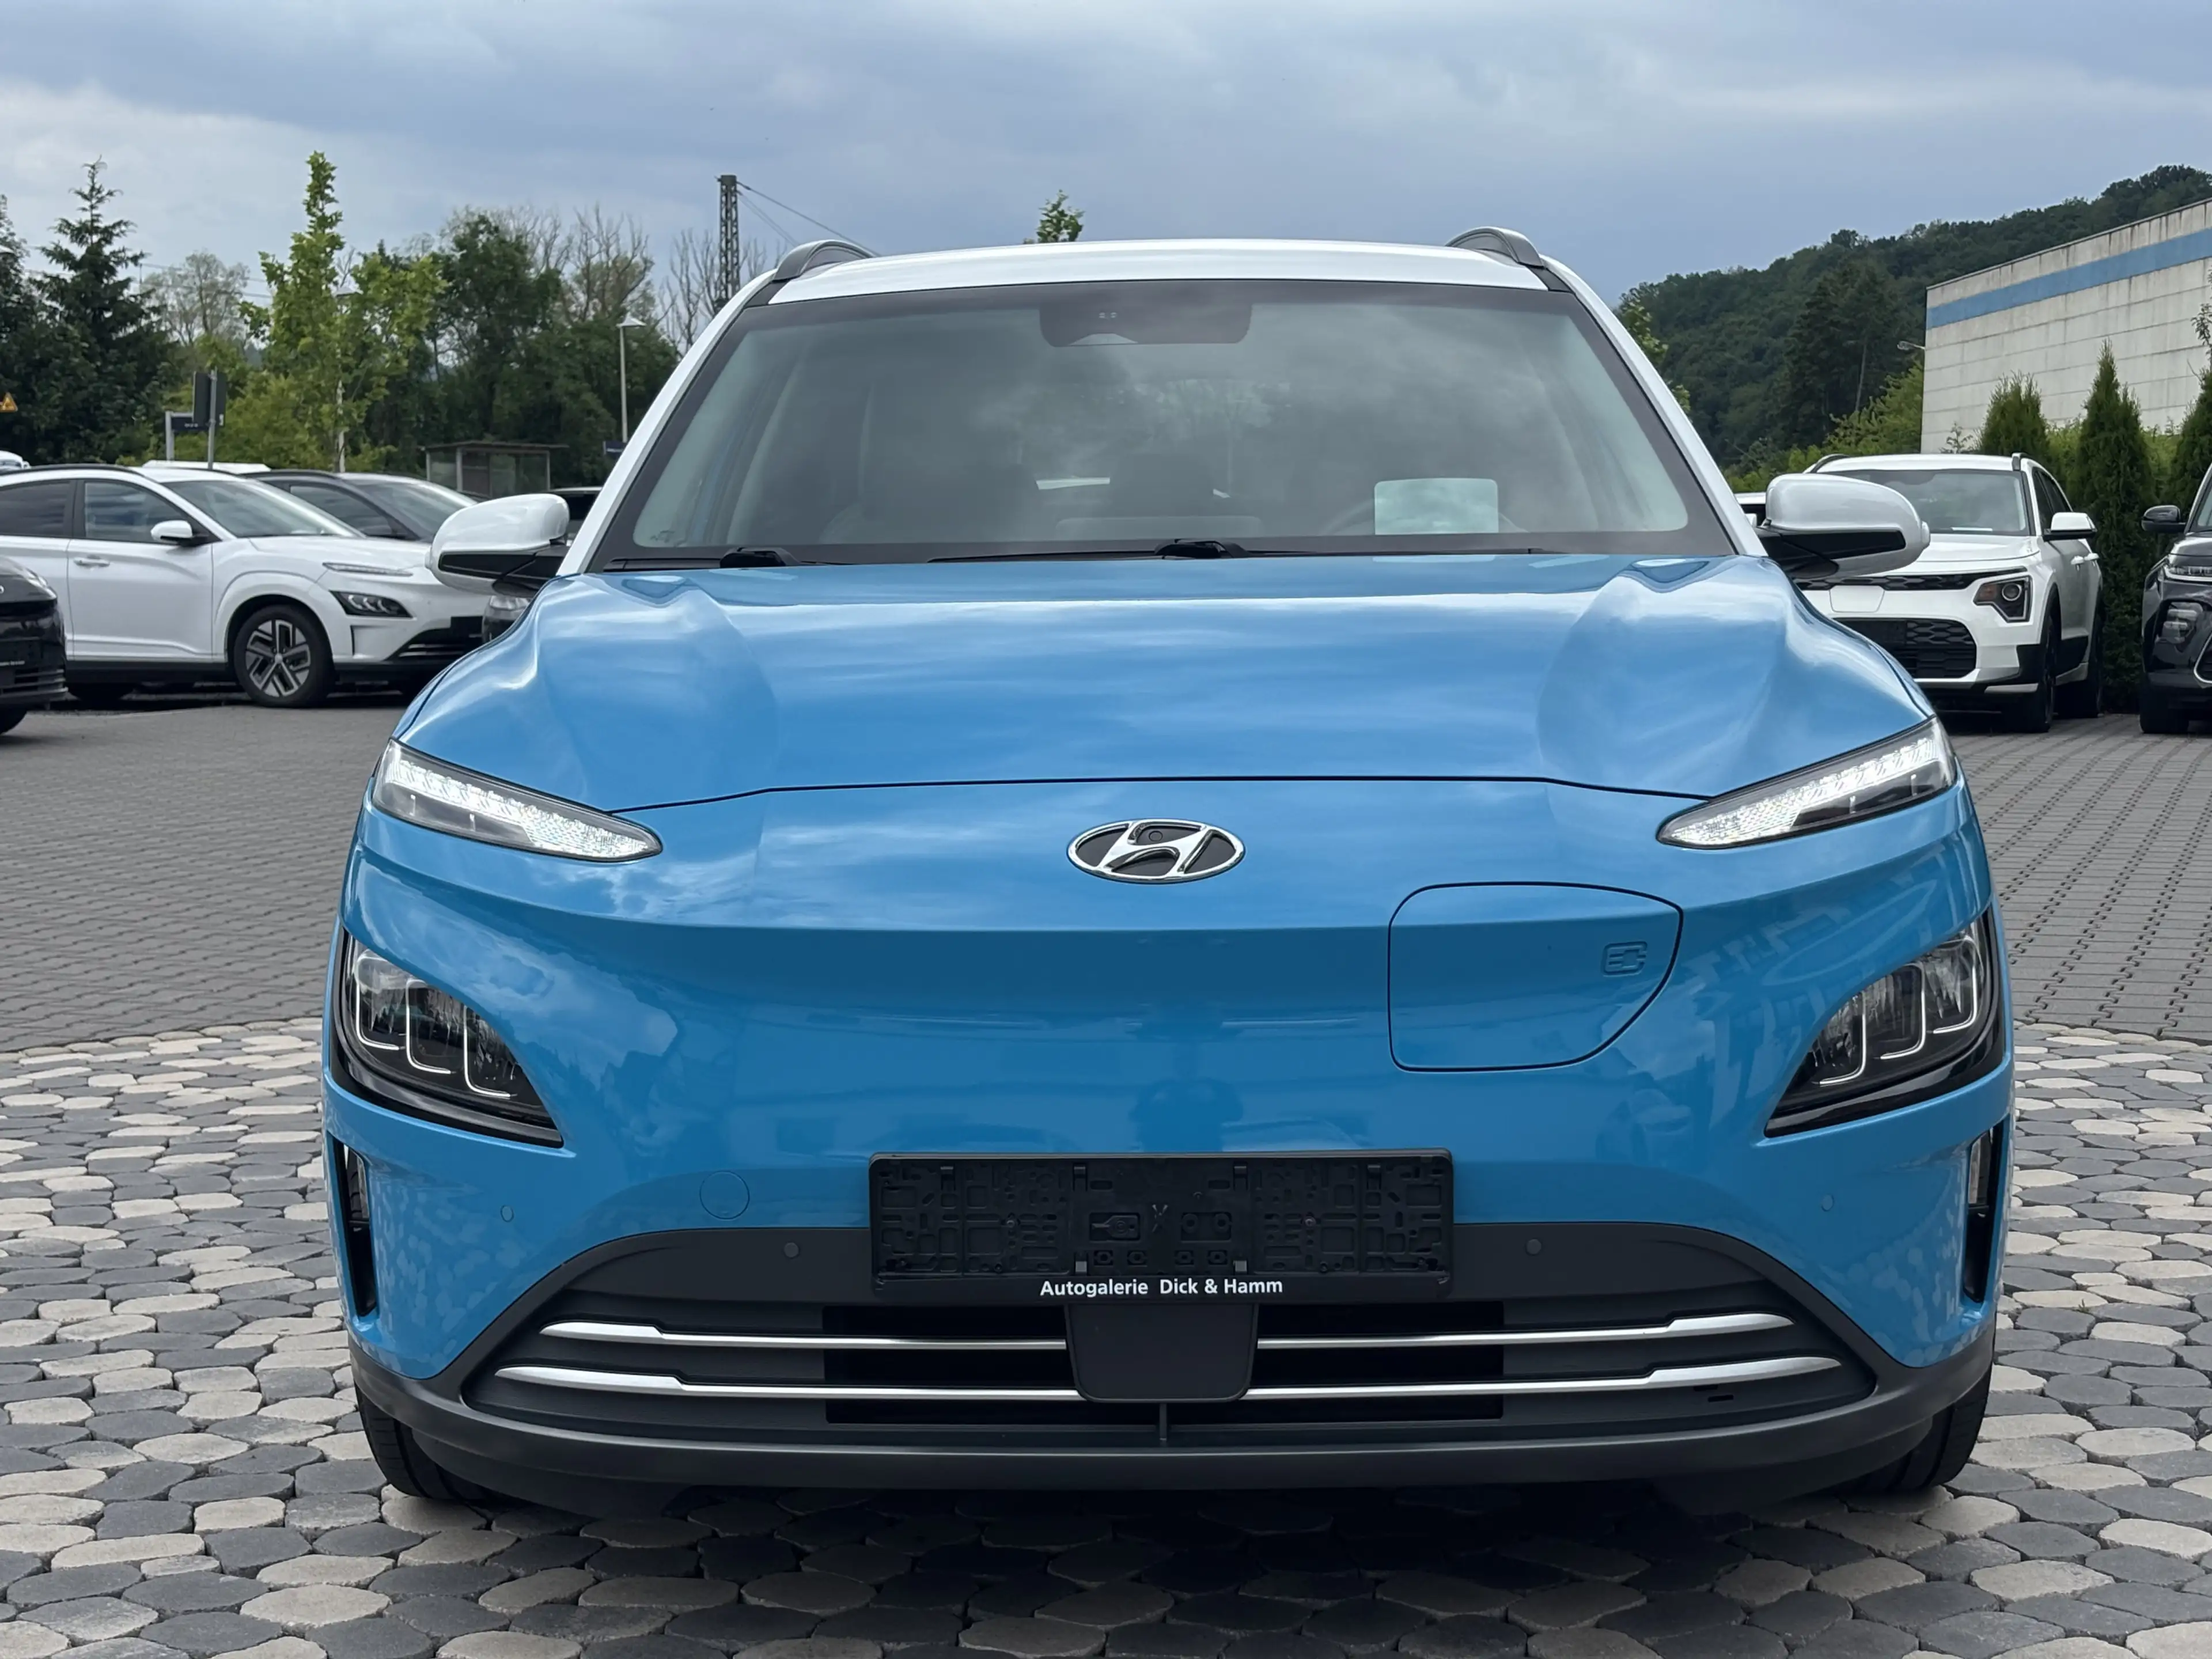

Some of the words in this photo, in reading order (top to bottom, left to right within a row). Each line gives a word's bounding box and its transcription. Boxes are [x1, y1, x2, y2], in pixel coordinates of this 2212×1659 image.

[1040, 1278, 1149, 1297] Autogalerie
[1160, 1278, 1198, 1294] Dick
[1205, 1278, 1218, 1294] &
[1224, 1278, 1283, 1294] Hamm
